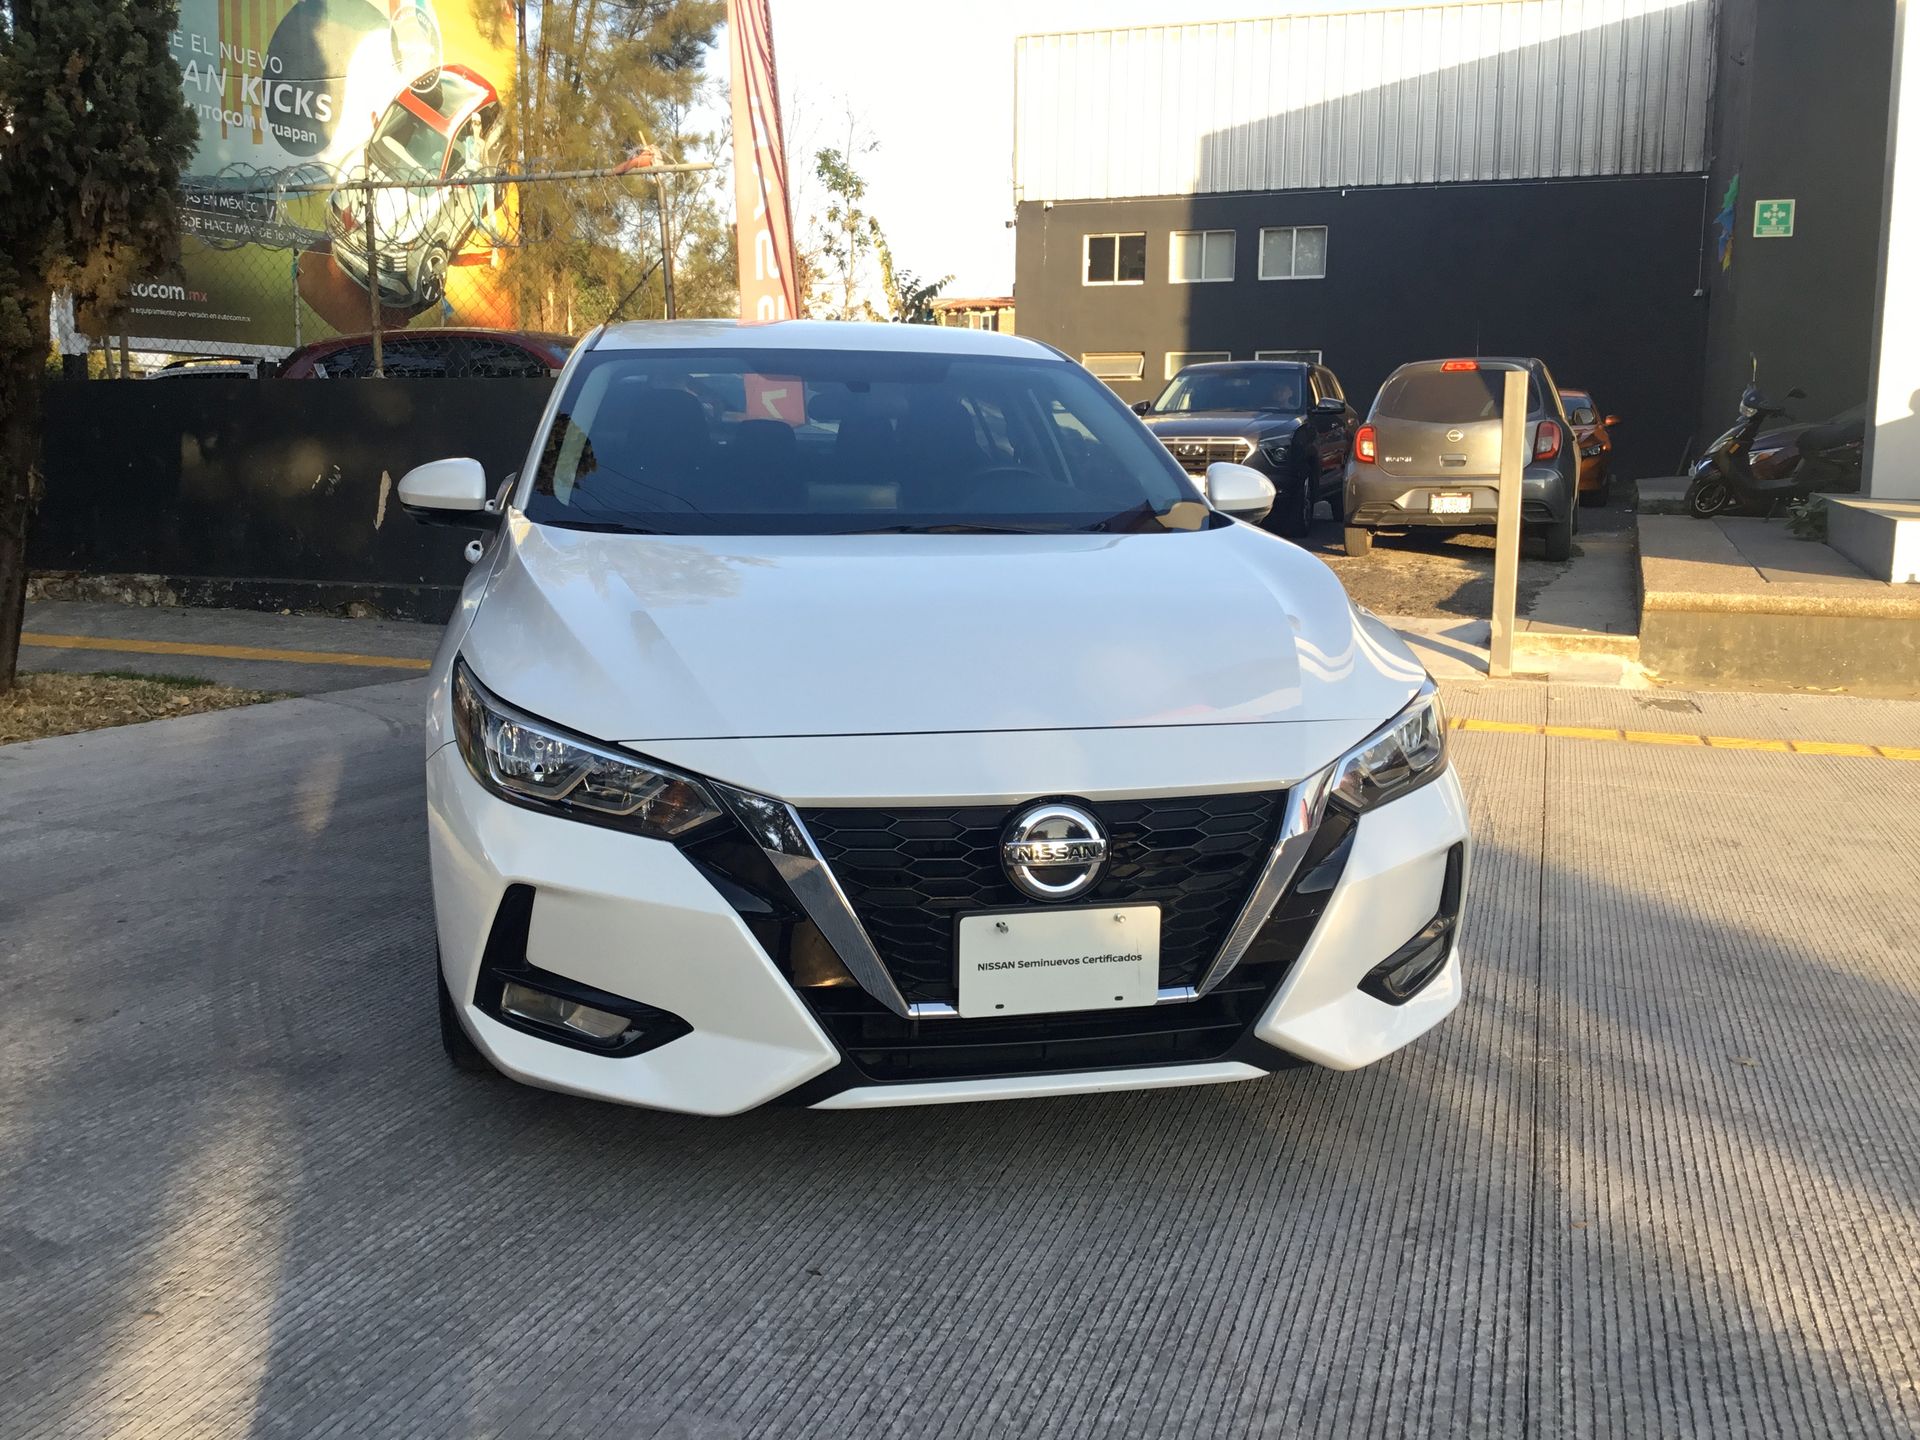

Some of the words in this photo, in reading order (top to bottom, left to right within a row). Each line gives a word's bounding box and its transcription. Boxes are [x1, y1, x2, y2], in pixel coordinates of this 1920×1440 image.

[191, 33, 214, 56] EL
[219, 41, 283, 74] NUEVO
[240, 73, 333, 123] KICKS
[184, 102, 257, 131] UTOCOM
[259, 116, 318, 145] Uruapan
[204, 218, 233, 233] HACE
[1017, 845, 1097, 862] NISSAN
[977, 961, 1016, 972] NISSAN
[1017, 957, 1081, 969] Seminuevos
[1082, 953, 1143, 965] Certificados
